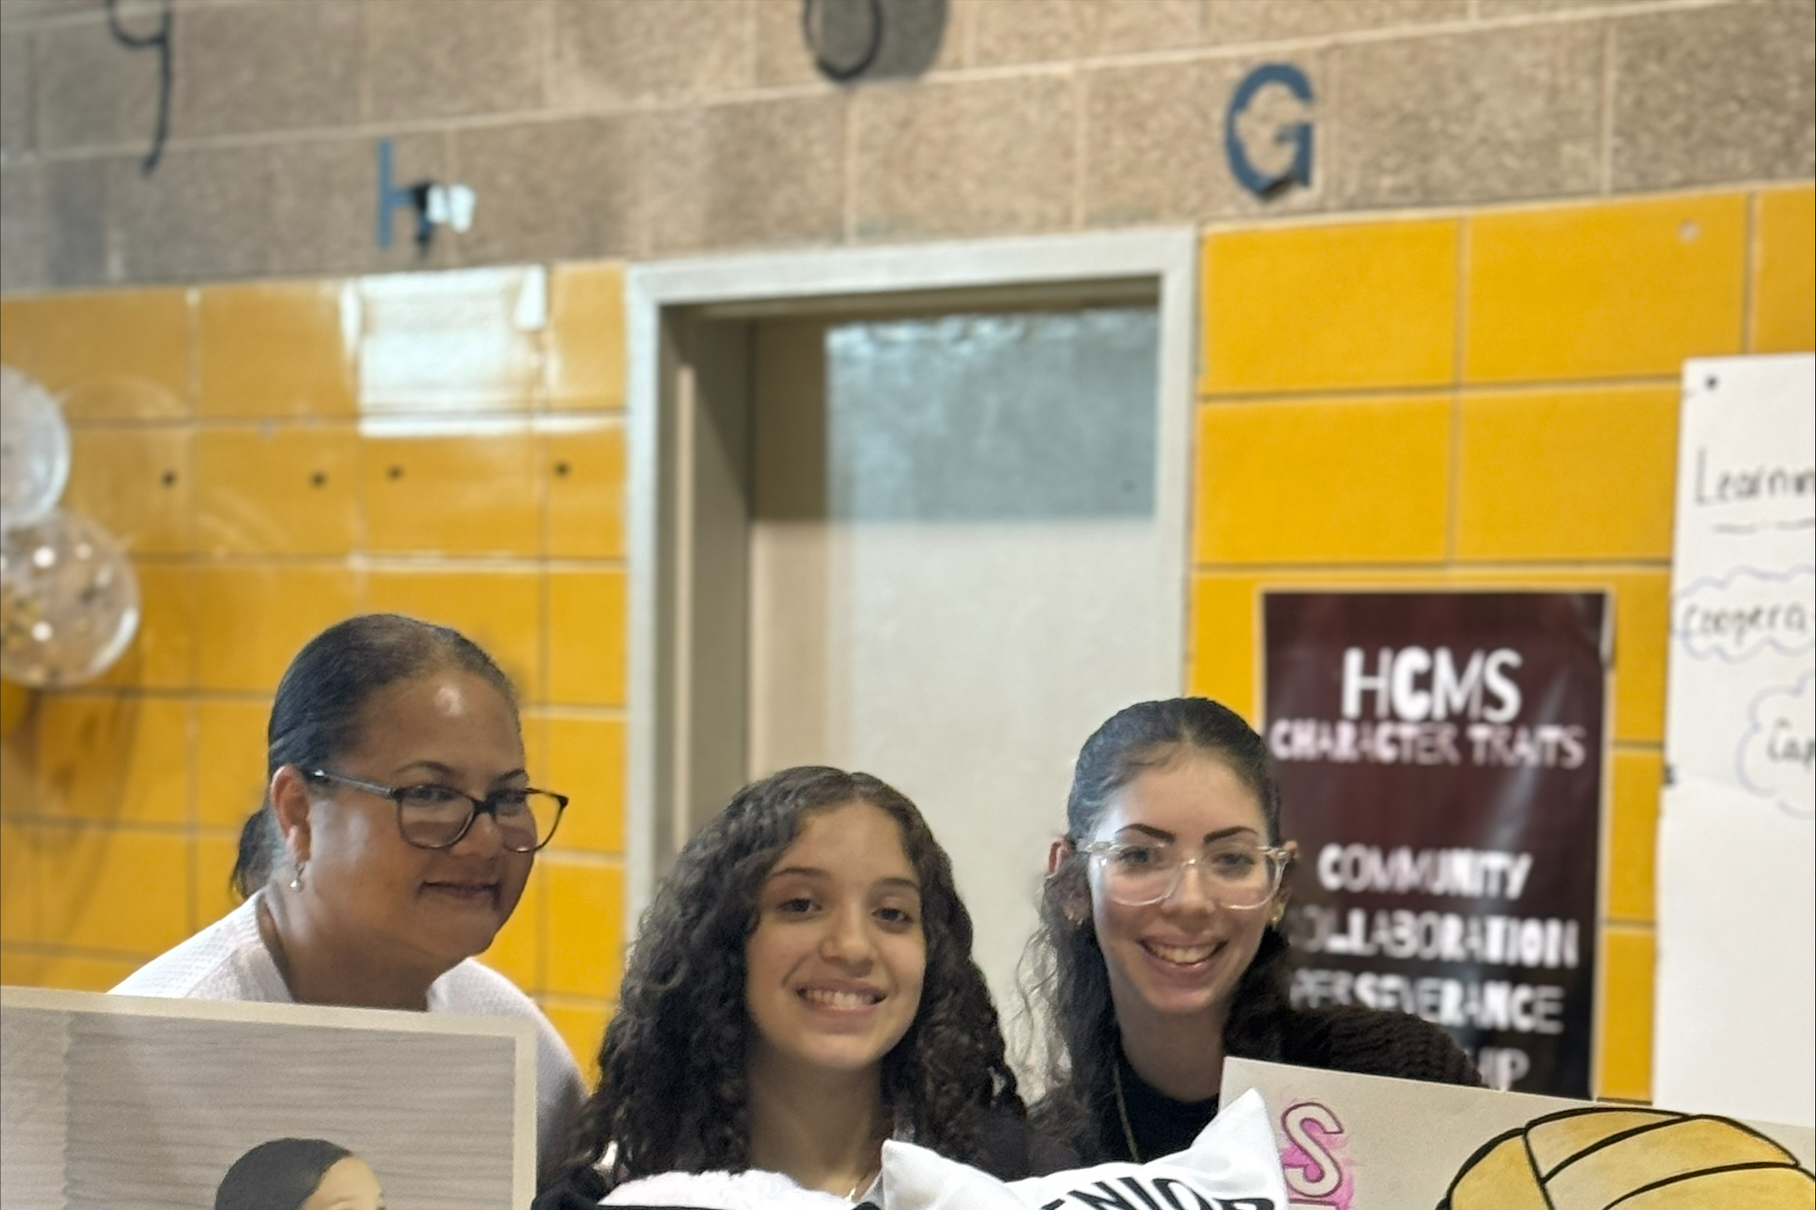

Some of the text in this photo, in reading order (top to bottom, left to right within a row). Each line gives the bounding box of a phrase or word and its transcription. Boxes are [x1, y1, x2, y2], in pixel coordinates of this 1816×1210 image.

[1224, 61, 1314, 202] G
[1342, 645, 1522, 723] HCMS
[1269, 718, 1587, 769] CHARACTER TRAITS
[1317, 843, 1532, 900] COMMUNITY
[1288, 967, 1566, 1035] PERSEVERANCE
